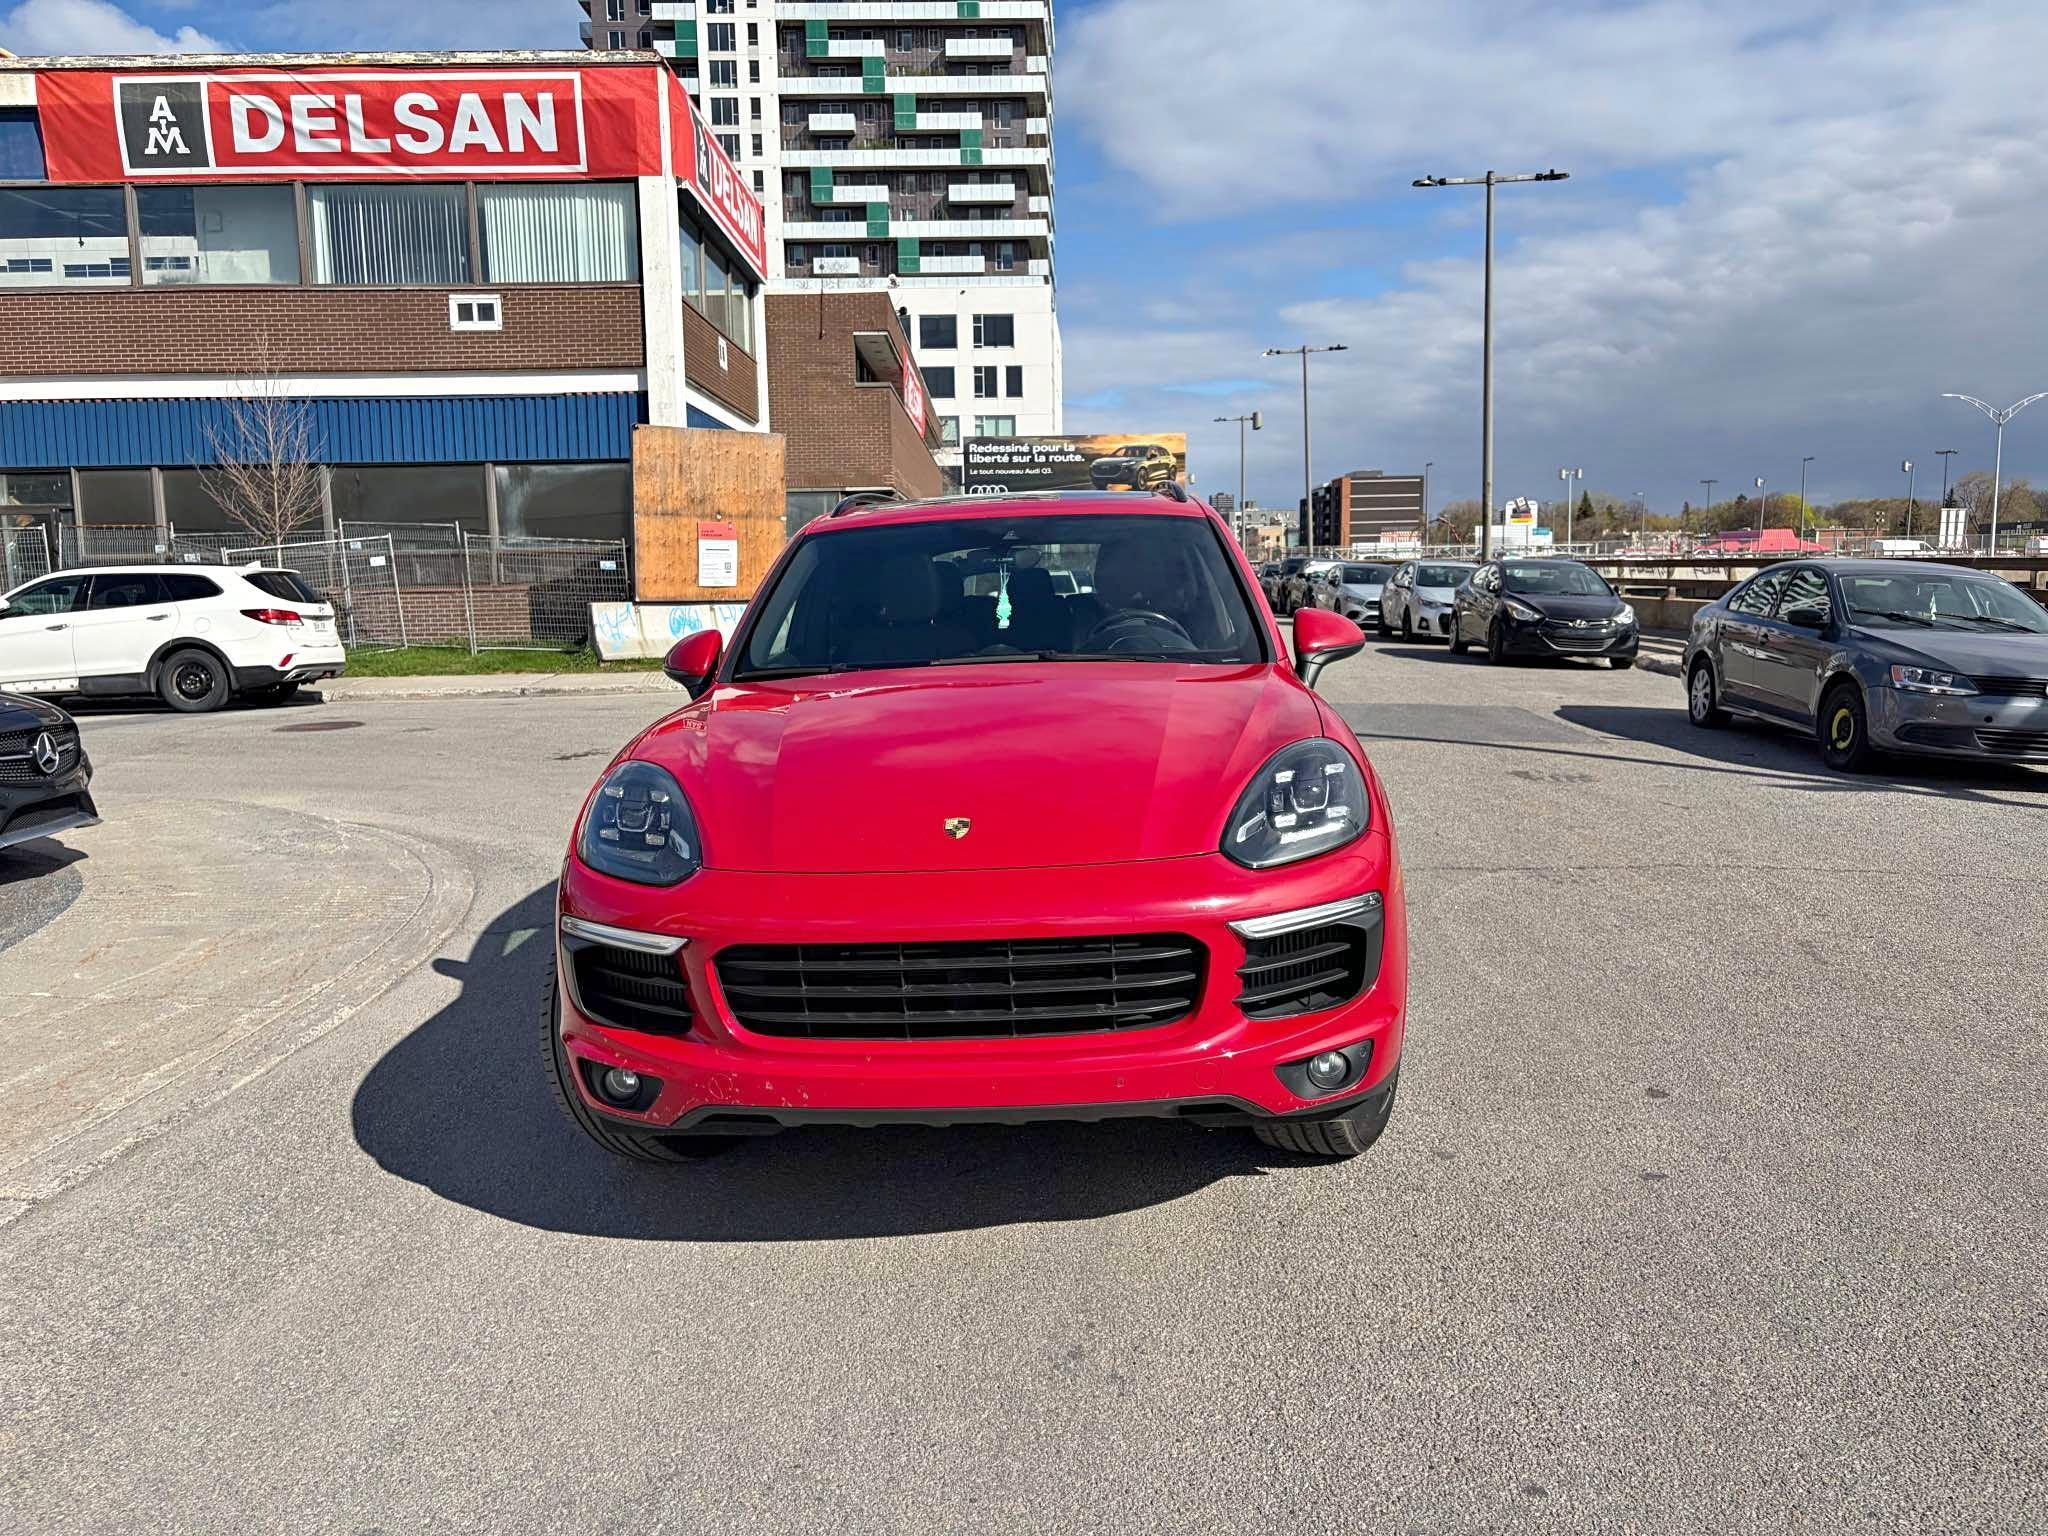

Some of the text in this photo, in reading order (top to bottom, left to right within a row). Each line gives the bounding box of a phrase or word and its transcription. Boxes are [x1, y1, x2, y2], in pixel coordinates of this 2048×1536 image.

[229, 92, 559, 154] DELSAN
[712, 152, 758, 246] DELSAN
[969, 443, 1075, 454] Redessiné pour la
[969, 453, 1085, 463] liberté sur la route.
